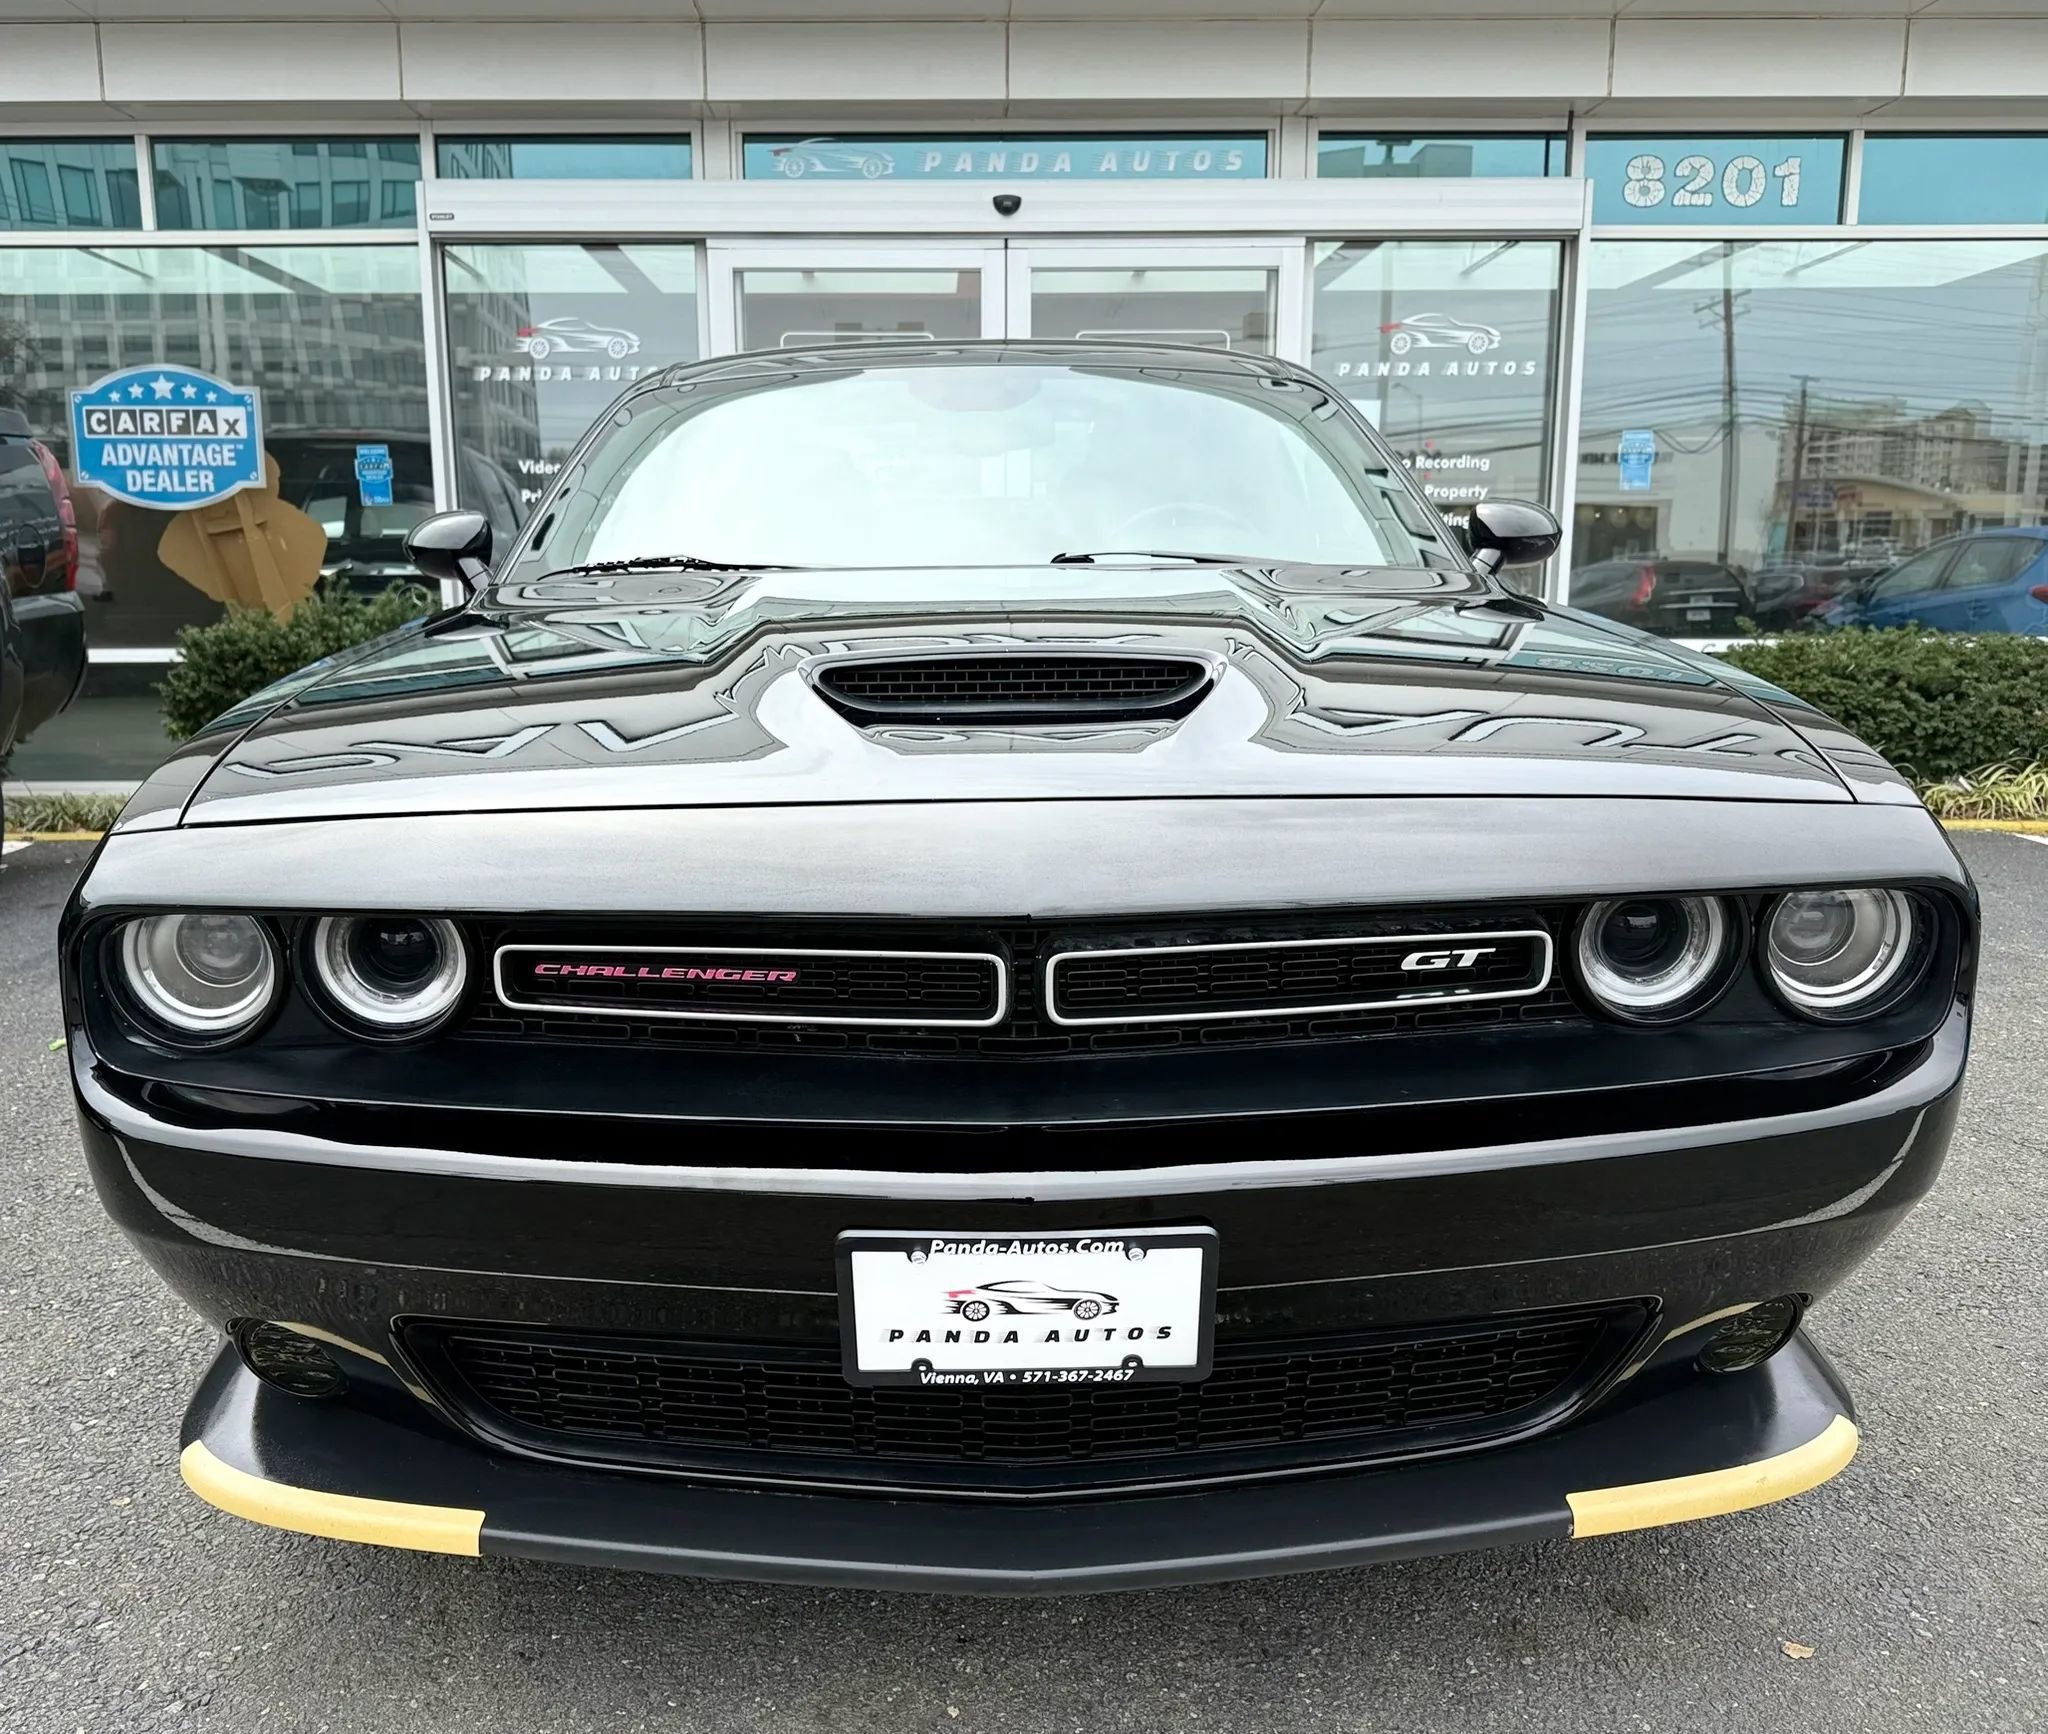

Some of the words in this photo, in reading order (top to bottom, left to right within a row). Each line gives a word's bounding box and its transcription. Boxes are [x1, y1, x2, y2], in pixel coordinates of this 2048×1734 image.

[922, 151, 1072, 173] PANDA
[1099, 150, 1244, 172] AUTOS
[1622, 153, 1802, 208] 8201
[478, 366, 573, 382] PANDA
[1338, 362, 1431, 377] PANDA
[1446, 361, 1537, 376] AUTOS
[89, 411, 241, 437] CARFAX
[1415, 455, 1490, 472] Recording
[126, 469, 216, 493] DEALER
[1424, 484, 1489, 501] Property
[1400, 948, 1497, 971] GT
[534, 964, 797, 982] CHALLENGER
[929, 1238, 1126, 1256] Panda-Autos.Com
[888, 1329, 1020, 1344] PANDA
[1044, 1325, 1172, 1343] AUTOS
[919, 1370, 980, 1385] Vienna,
[982, 1371, 1005, 1384] VA
[1021, 1369, 1135, 1384] 571-367-2467
